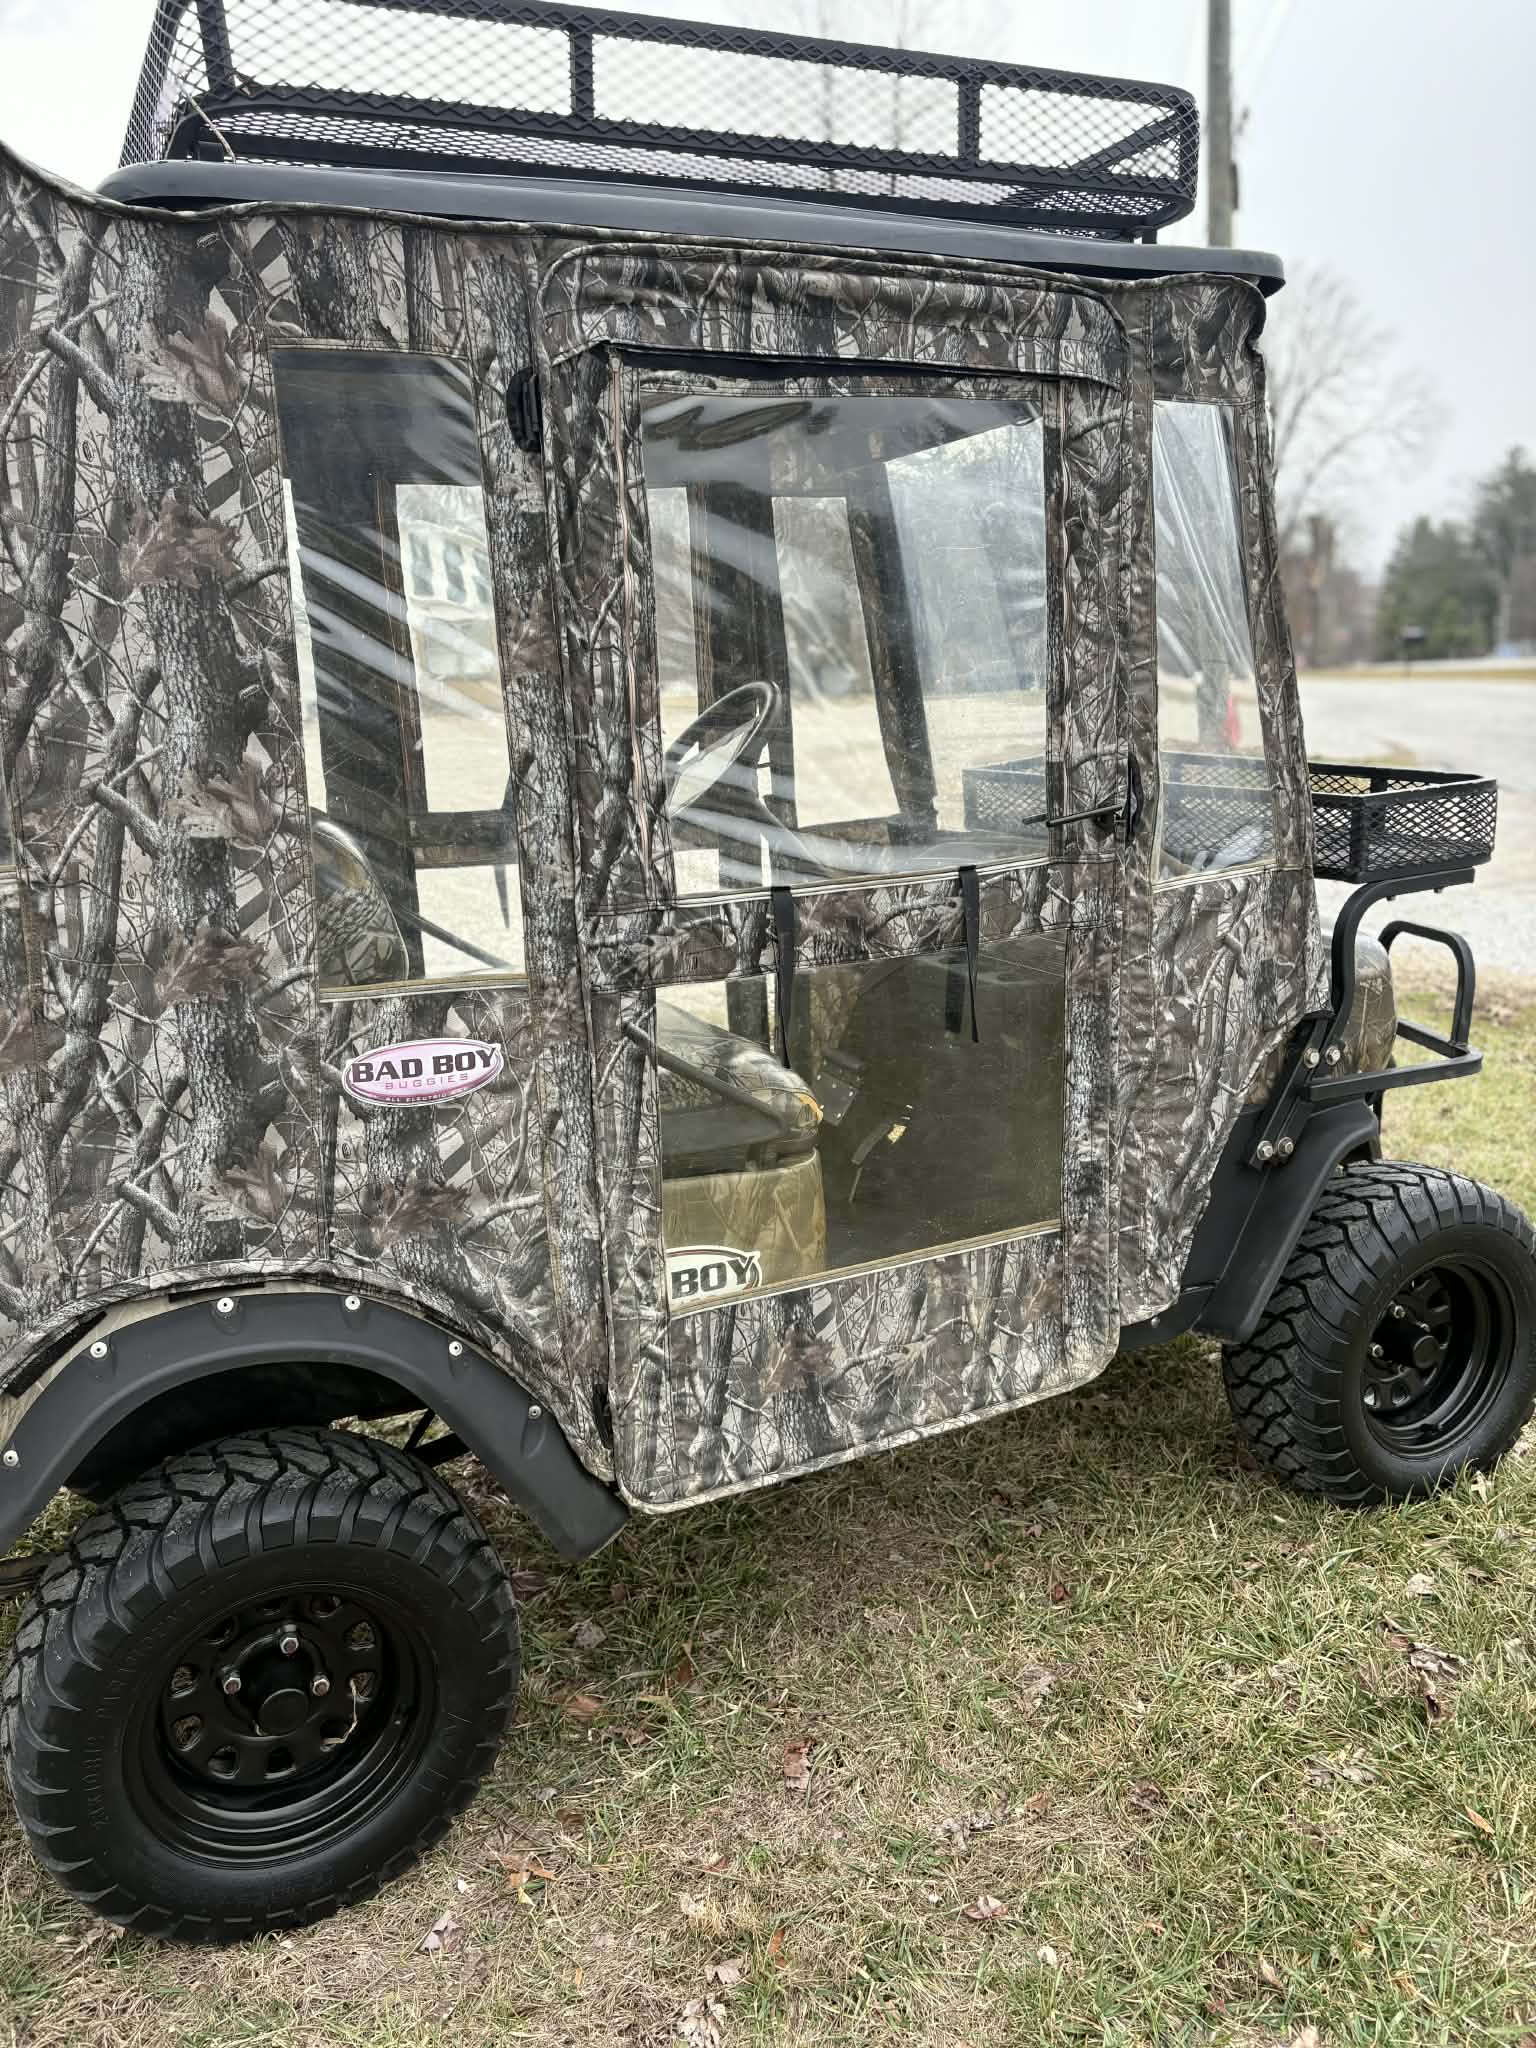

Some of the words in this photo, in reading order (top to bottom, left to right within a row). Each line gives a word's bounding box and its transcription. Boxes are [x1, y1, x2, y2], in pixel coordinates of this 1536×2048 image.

[351, 1058, 423, 1083] BAD
[432, 1047, 497, 1075] BOY
[385, 1073, 469, 1090] BUGGIES
[671, 1255, 755, 1299] BOY
